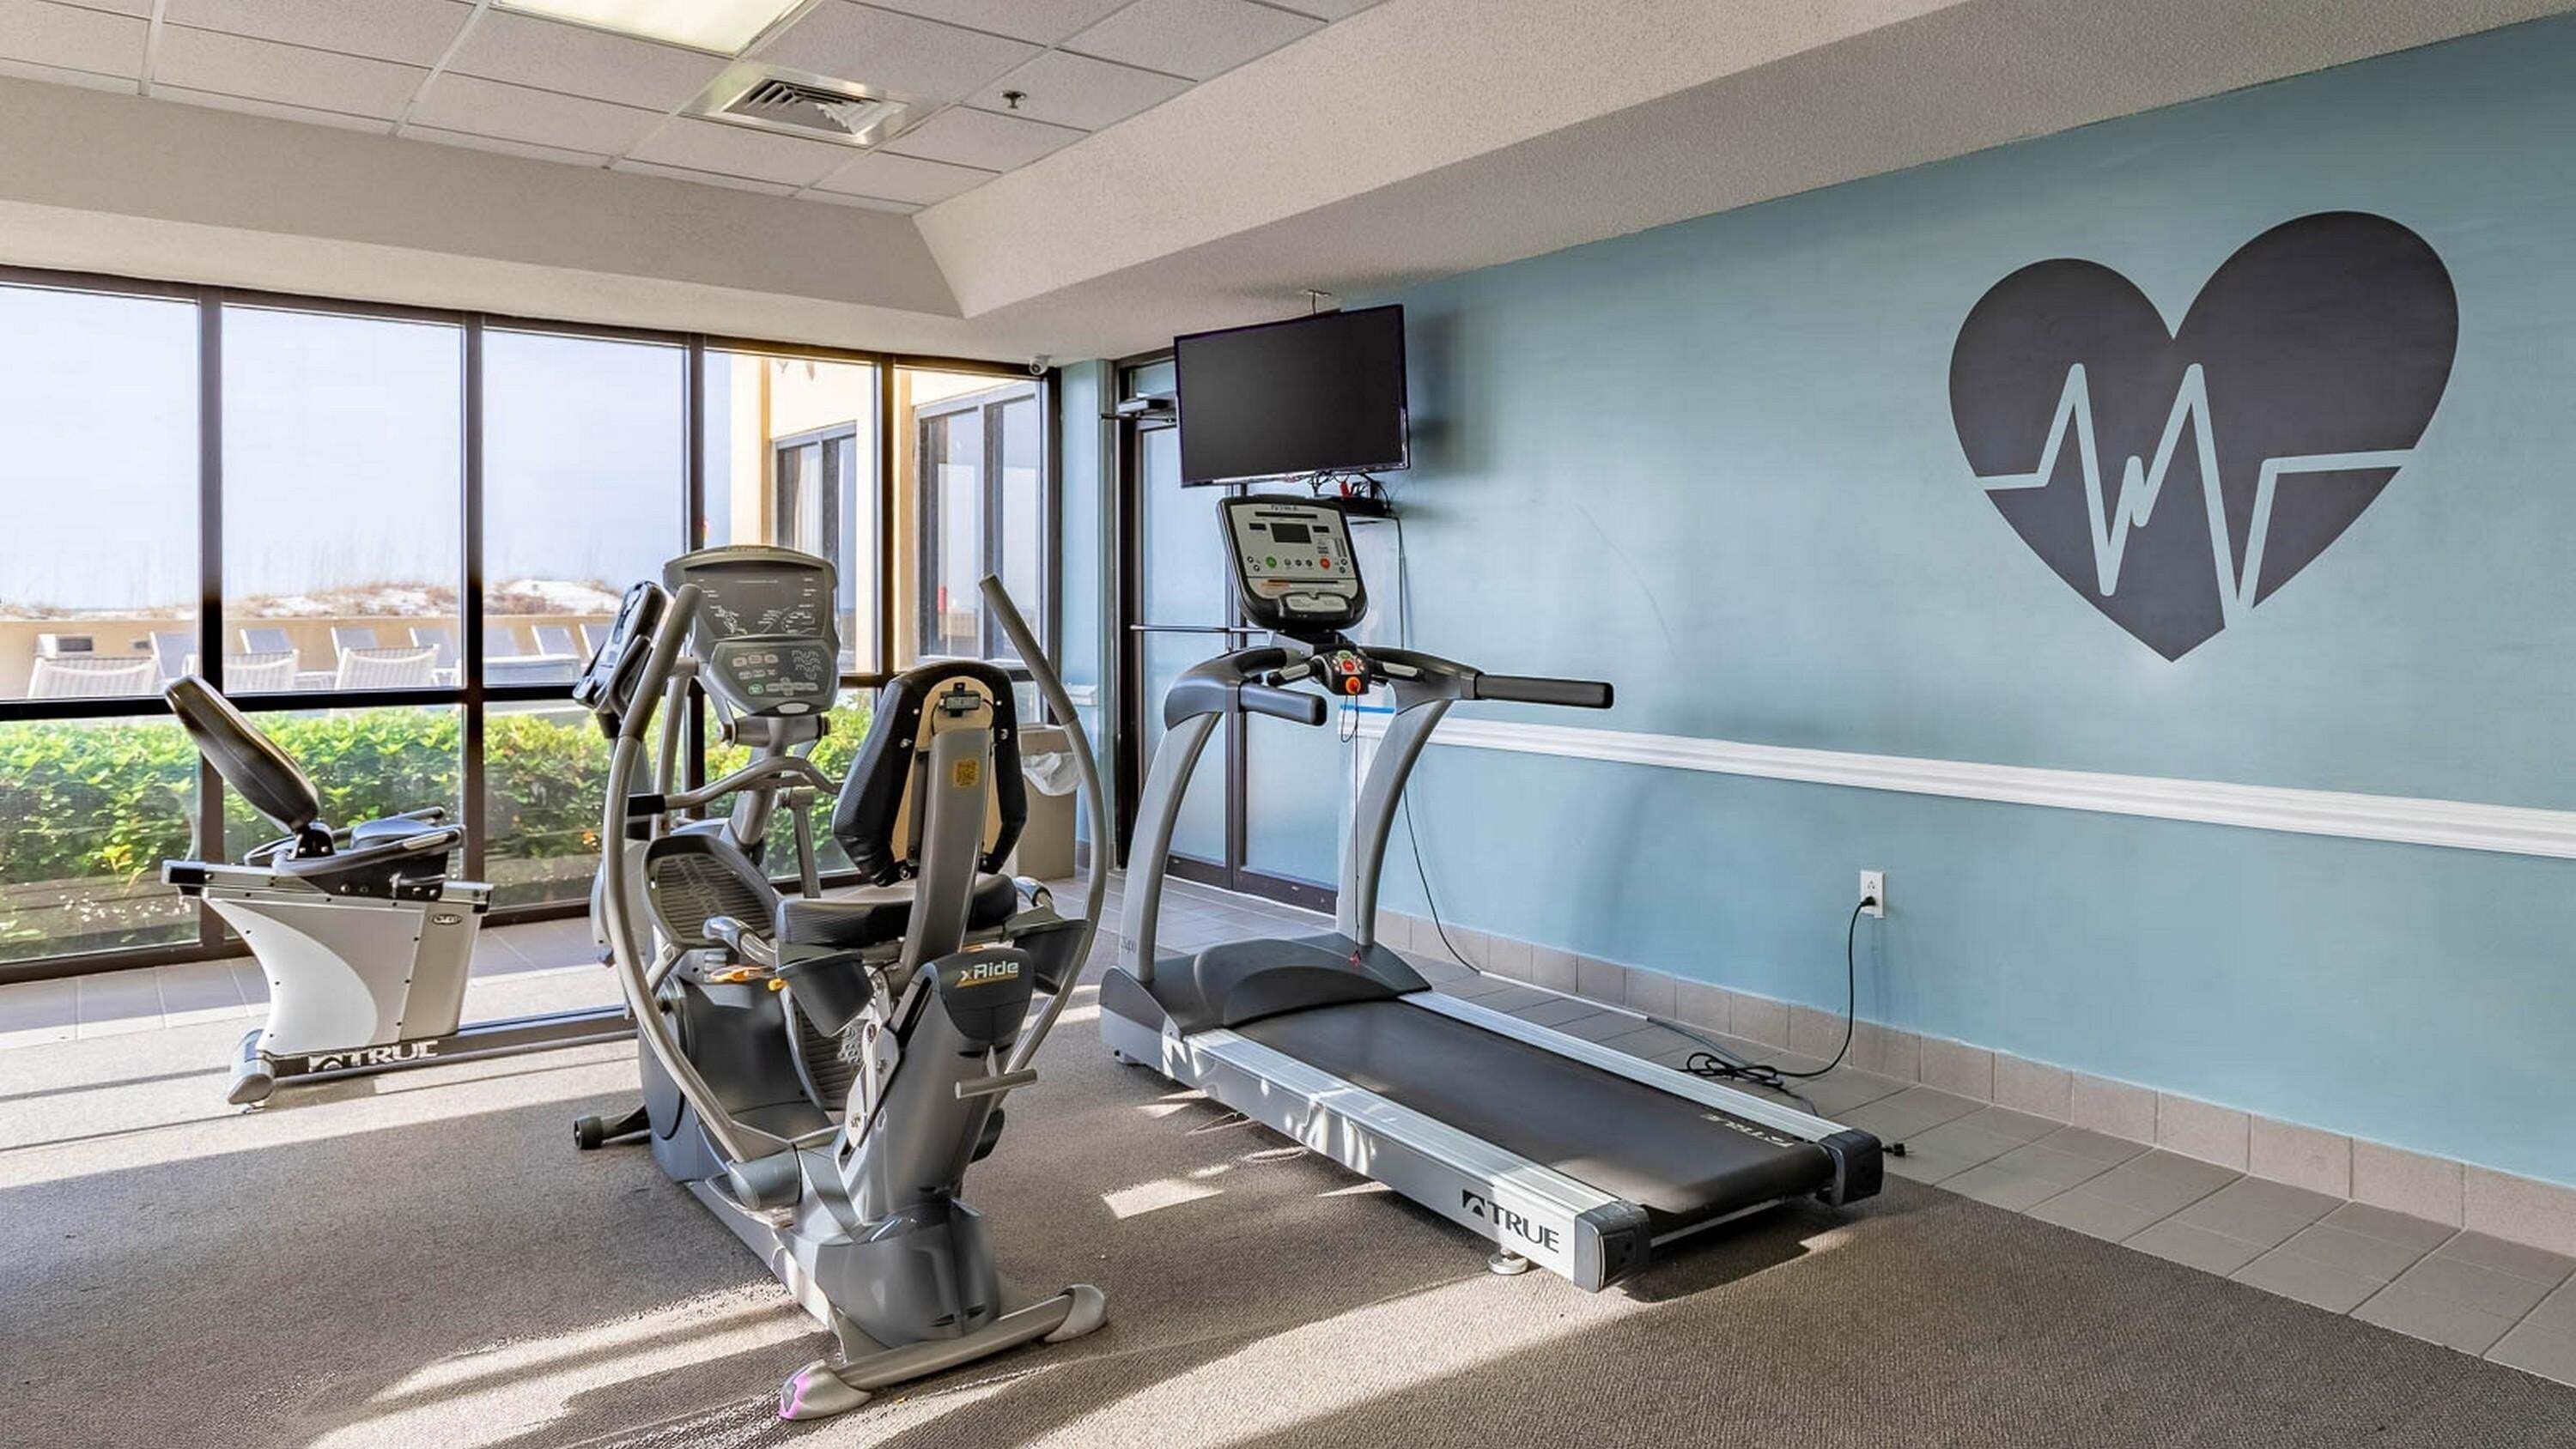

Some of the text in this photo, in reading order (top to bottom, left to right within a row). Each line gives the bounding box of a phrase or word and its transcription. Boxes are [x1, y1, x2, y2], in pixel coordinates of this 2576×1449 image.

[960, 961, 1019, 982] xRide
[345, 1040, 439, 1067] TRUE
[1486, 1200, 1559, 1254] TRUE
